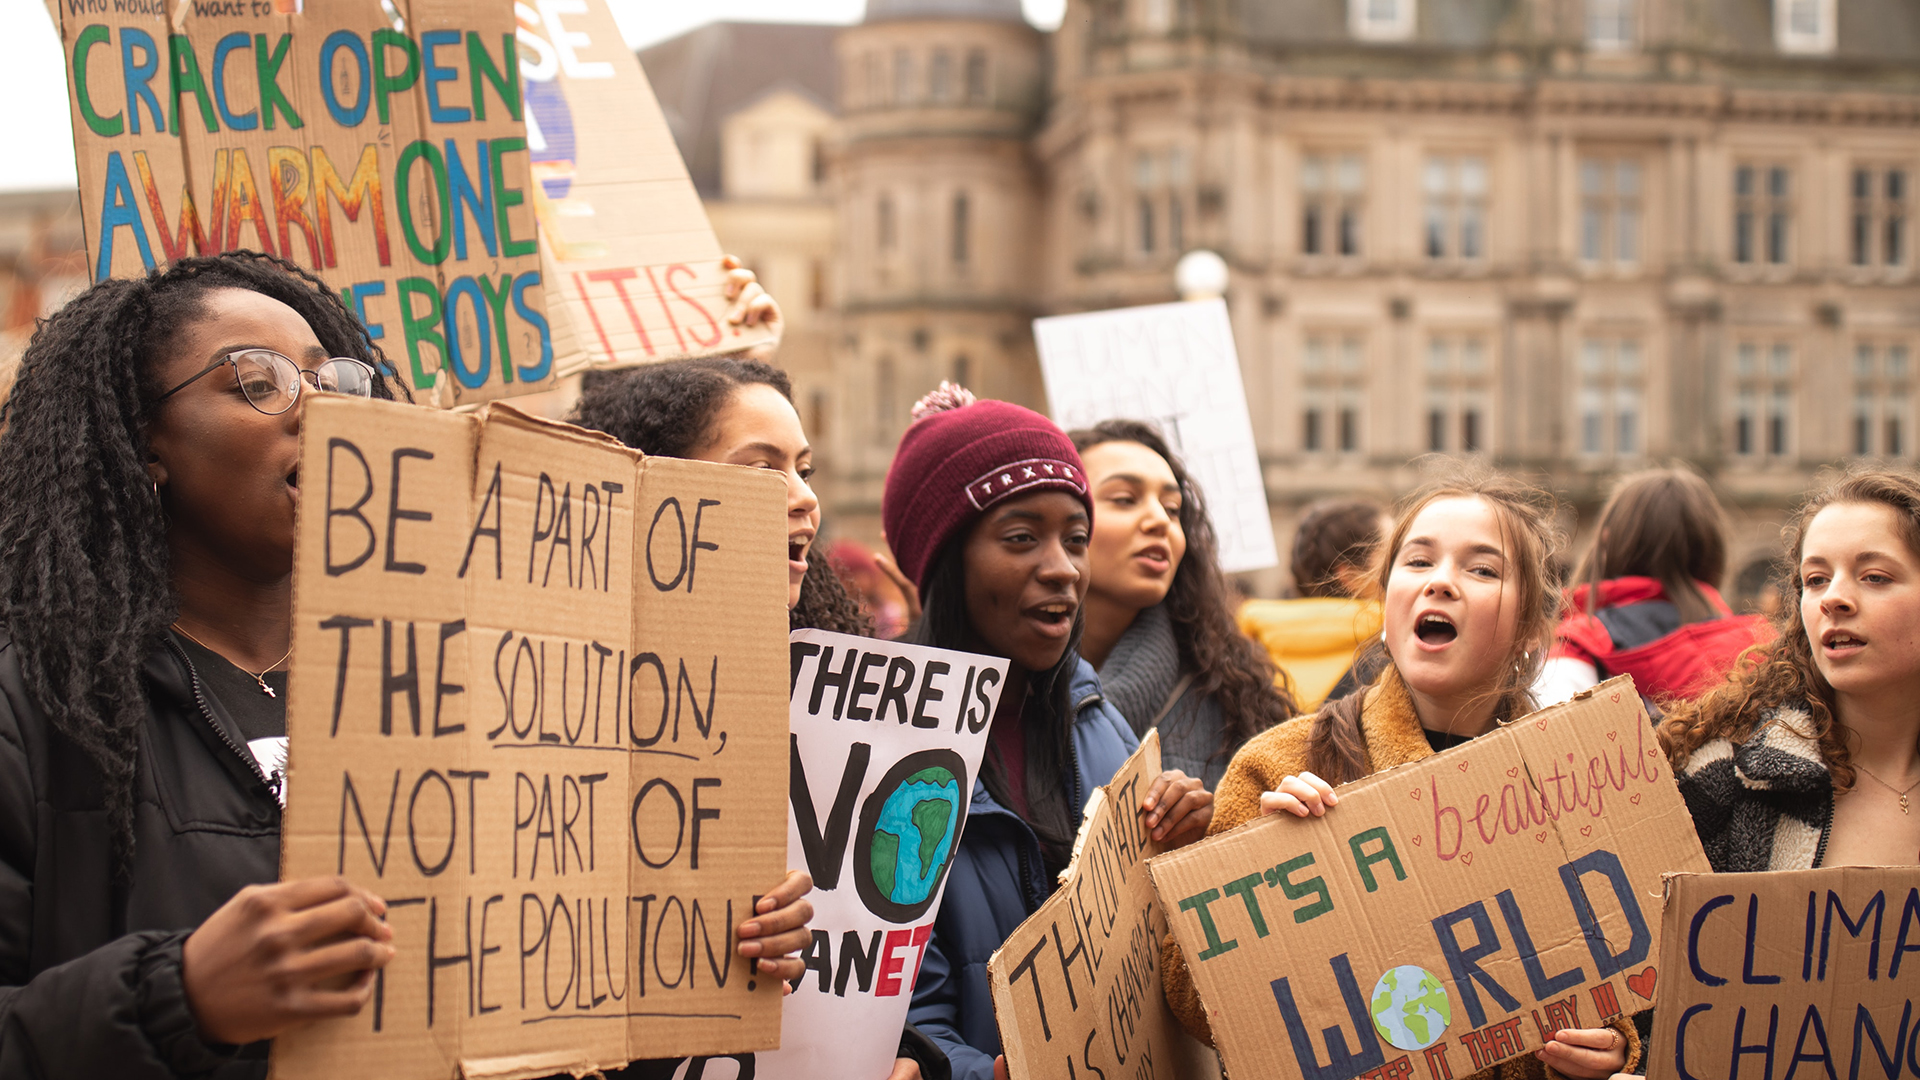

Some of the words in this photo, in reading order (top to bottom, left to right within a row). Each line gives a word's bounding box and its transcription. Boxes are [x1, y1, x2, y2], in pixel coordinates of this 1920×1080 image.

[193, 0, 244, 17] want
[251, 0, 272, 17] to
[73, 24, 305, 137] CRACK
[319, 28, 525, 128] OPEN
[96, 150, 157, 282] A
[132, 142, 391, 271] WARM
[395, 137, 538, 266] ONE
[396, 271, 554, 390] BOYS
[325, 436, 435, 577] BE
[457, 460, 502, 580] A
[527, 470, 624, 592] PART
[645, 496, 722, 594] OF
[318, 614, 466, 738] THE
[486, 629, 728, 756] SOLUTION,
[790, 641, 951, 730] THERE
[955, 664, 1001, 735] IS
[337, 768, 490, 878] NOT
[512, 770, 609, 881] PART
[631, 777, 722, 871] OF
[790, 732, 968, 924] NO
[1178, 851, 1335, 962] IT'S
[1348, 826, 1409, 893] A
[1432, 709, 1660, 862] beautiful
[372, 894, 504, 1033] THE
[790, 921, 936, 997] ANET
[1008, 872, 1104, 1042] THE
[1089, 772, 1148, 939] CLIMATE
[1066, 1027, 1106, 1080] S
[1423, 1042, 1454, 1080] IT
[1459, 1015, 1526, 1071] THAT
[1531, 993, 1583, 1044] WAY
